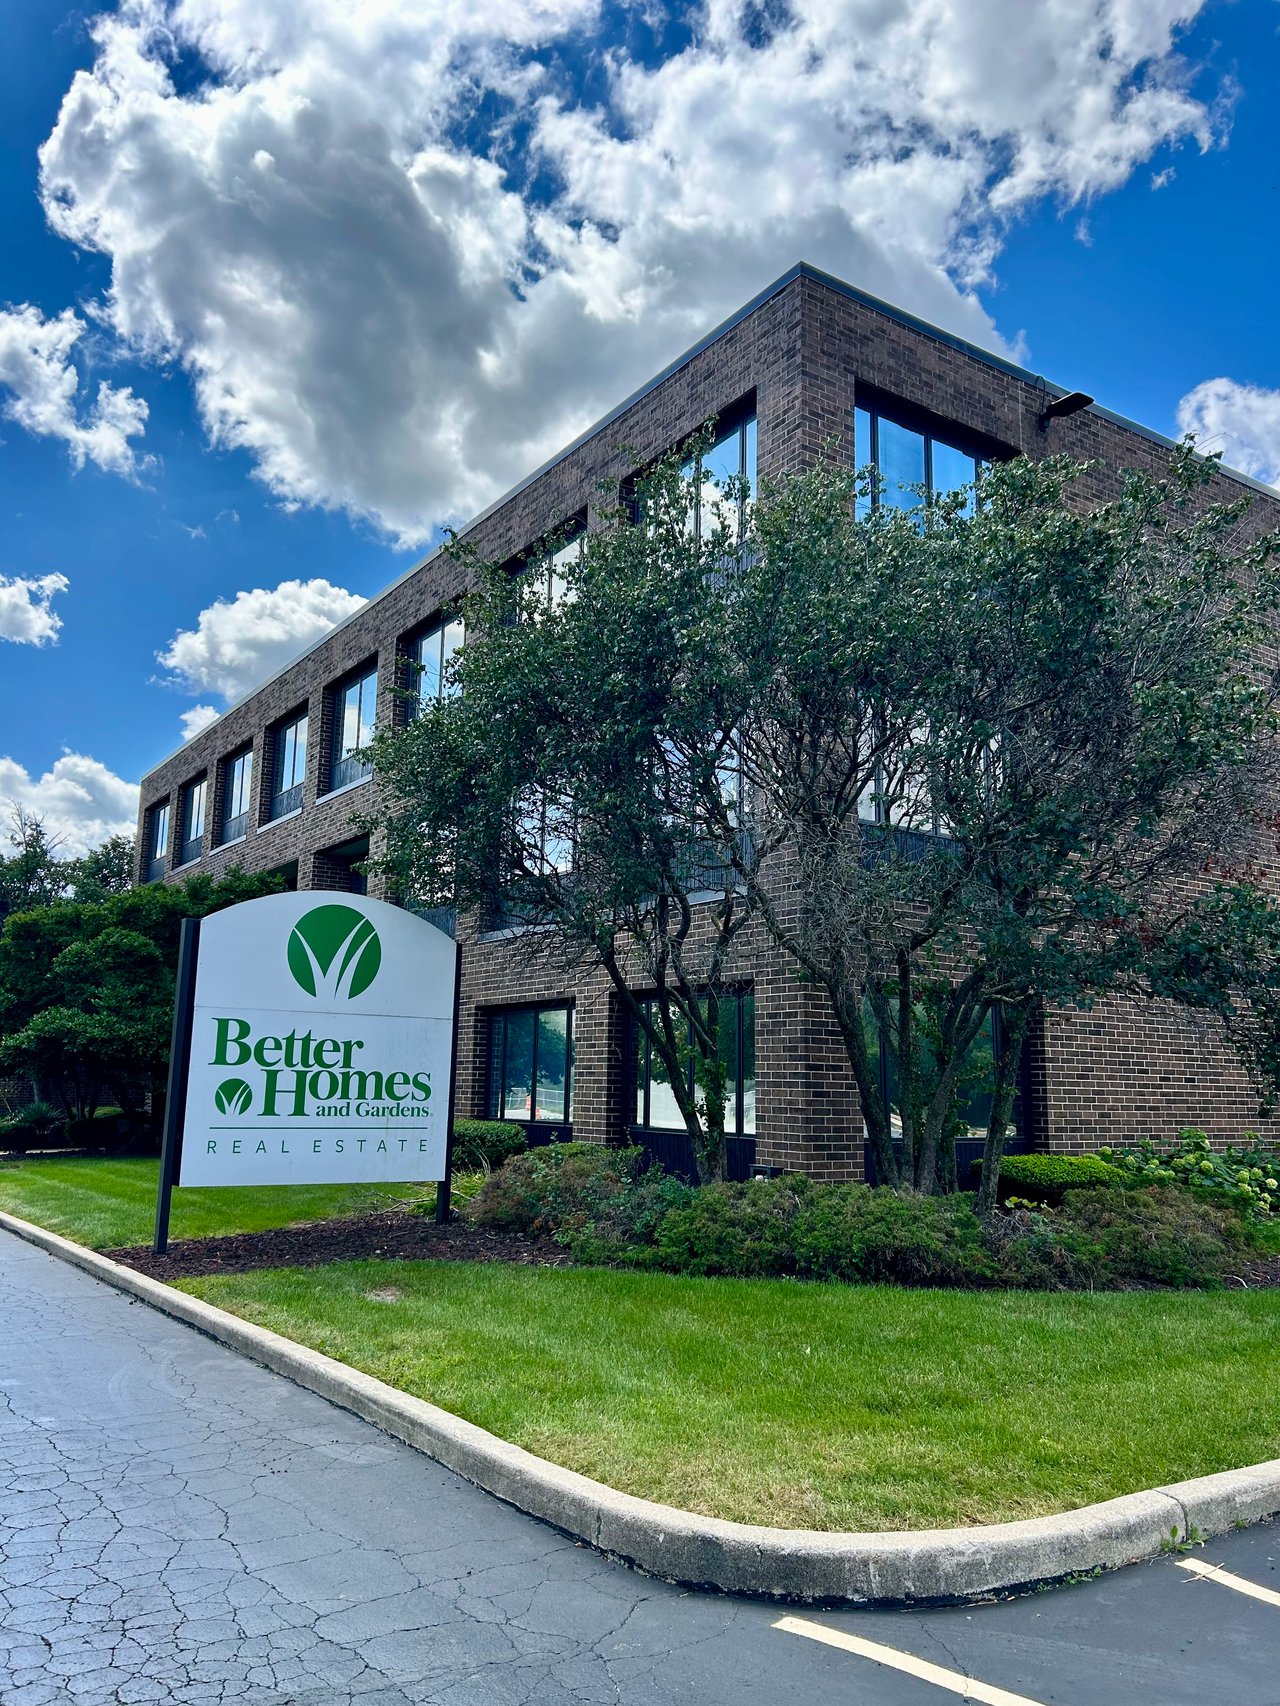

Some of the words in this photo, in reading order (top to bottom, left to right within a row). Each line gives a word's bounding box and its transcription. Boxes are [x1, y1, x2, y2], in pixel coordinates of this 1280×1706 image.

[208, 1017, 364, 1069] Better
[257, 1069, 432, 1117] Homes
[316, 1102, 350, 1117] and
[356, 1102, 429, 1117] Gardens
[207, 1140, 290, 1154] REAL
[313, 1139, 428, 1153] ESTATE
